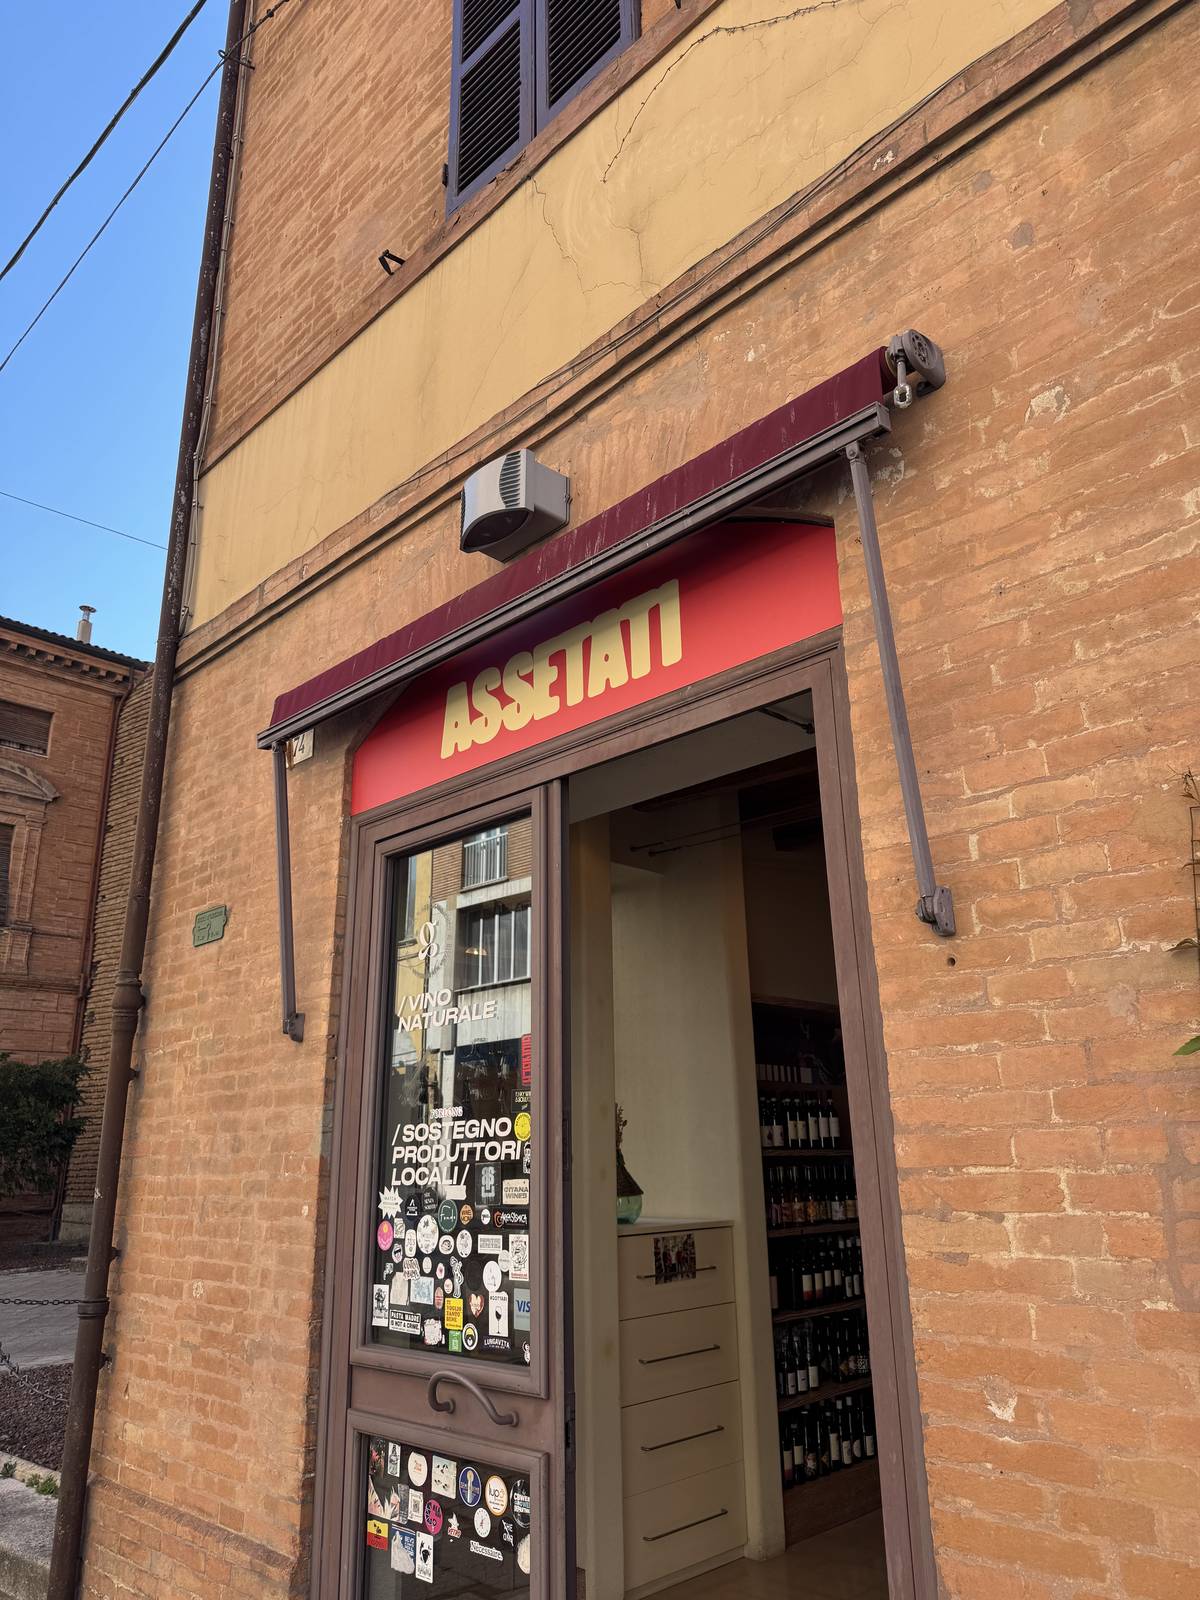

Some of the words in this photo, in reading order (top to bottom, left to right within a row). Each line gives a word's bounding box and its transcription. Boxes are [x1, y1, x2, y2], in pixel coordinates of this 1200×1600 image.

[440, 579, 682, 760] ASSETATI
[397, 1000, 497, 1033] NATURALE
[392, 1140, 522, 1165] PRODUTTORI
[516, 1299, 531, 1312] VIS
